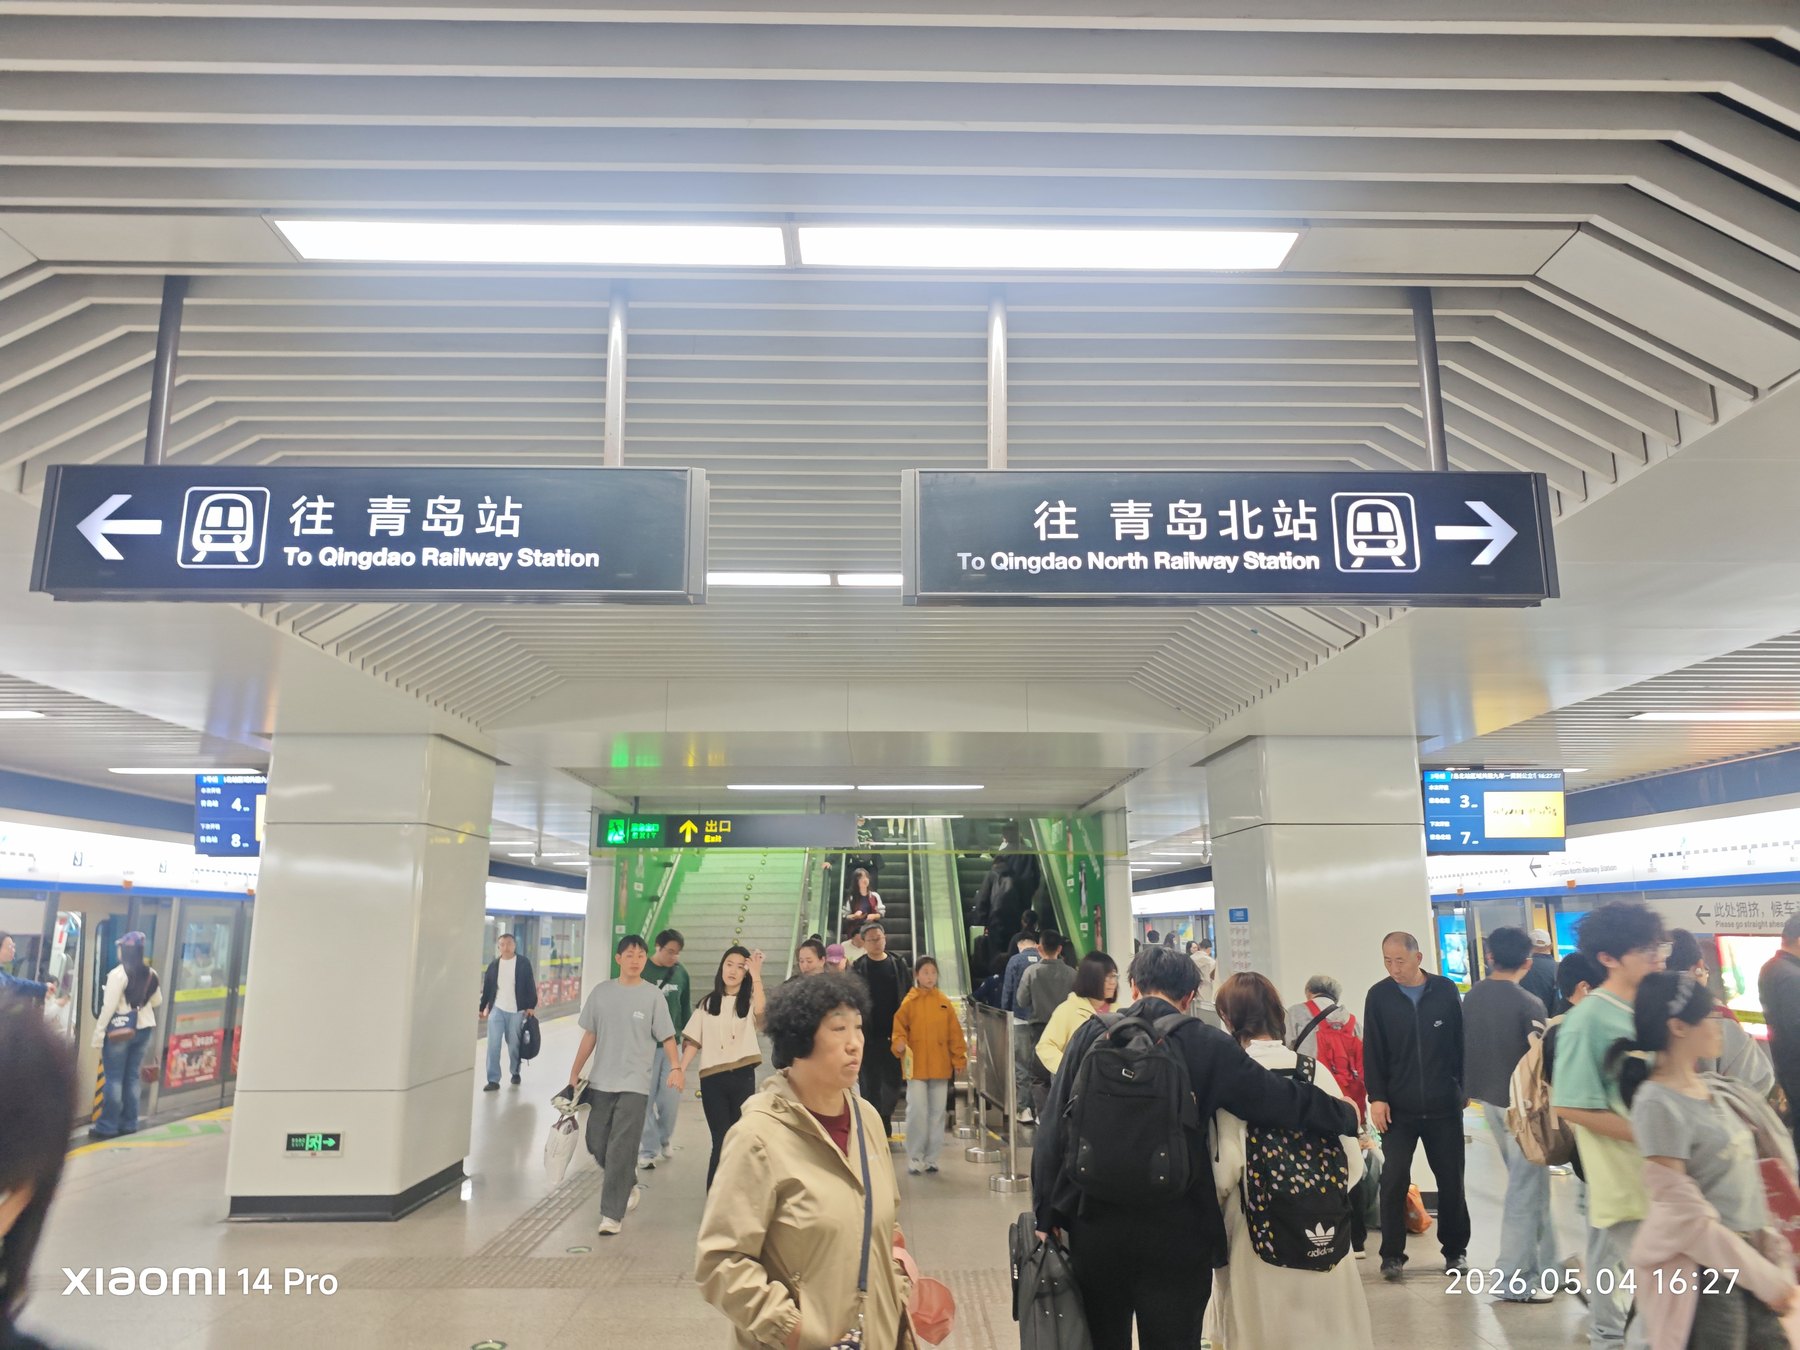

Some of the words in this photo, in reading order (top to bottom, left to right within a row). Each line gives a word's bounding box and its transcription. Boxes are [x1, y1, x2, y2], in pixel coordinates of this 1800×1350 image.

[289, 494, 335, 537] 往
[366, 494, 523, 538] 青岛站
[1033, 499, 1080, 542] 往
[1109, 498, 1318, 542] 青岛北站
[282, 546, 313, 567] To
[318, 546, 417, 571] Qingdao
[421, 546, 512, 570] Railway
[516, 546, 600, 568] Station
[957, 551, 985, 570] To
[990, 551, 1083, 575] Qingdao
[1087, 551, 1149, 570] North
[1153, 550, 1237, 573] Railway
[1242, 551, 1320, 570] Station
[231, 797, 242, 812] 4
[1459, 794, 1470, 809] 3
[705, 820, 731, 832] 出口
[231, 834, 241, 848] 8
[704, 834, 722, 843] Exit
[1460, 831, 1472, 845] 7
[1714, 901, 1800, 918] 此处拥挤，候车
[1715, 920, 1735, 928] Please
[1745, 920, 1768, 929] straight
